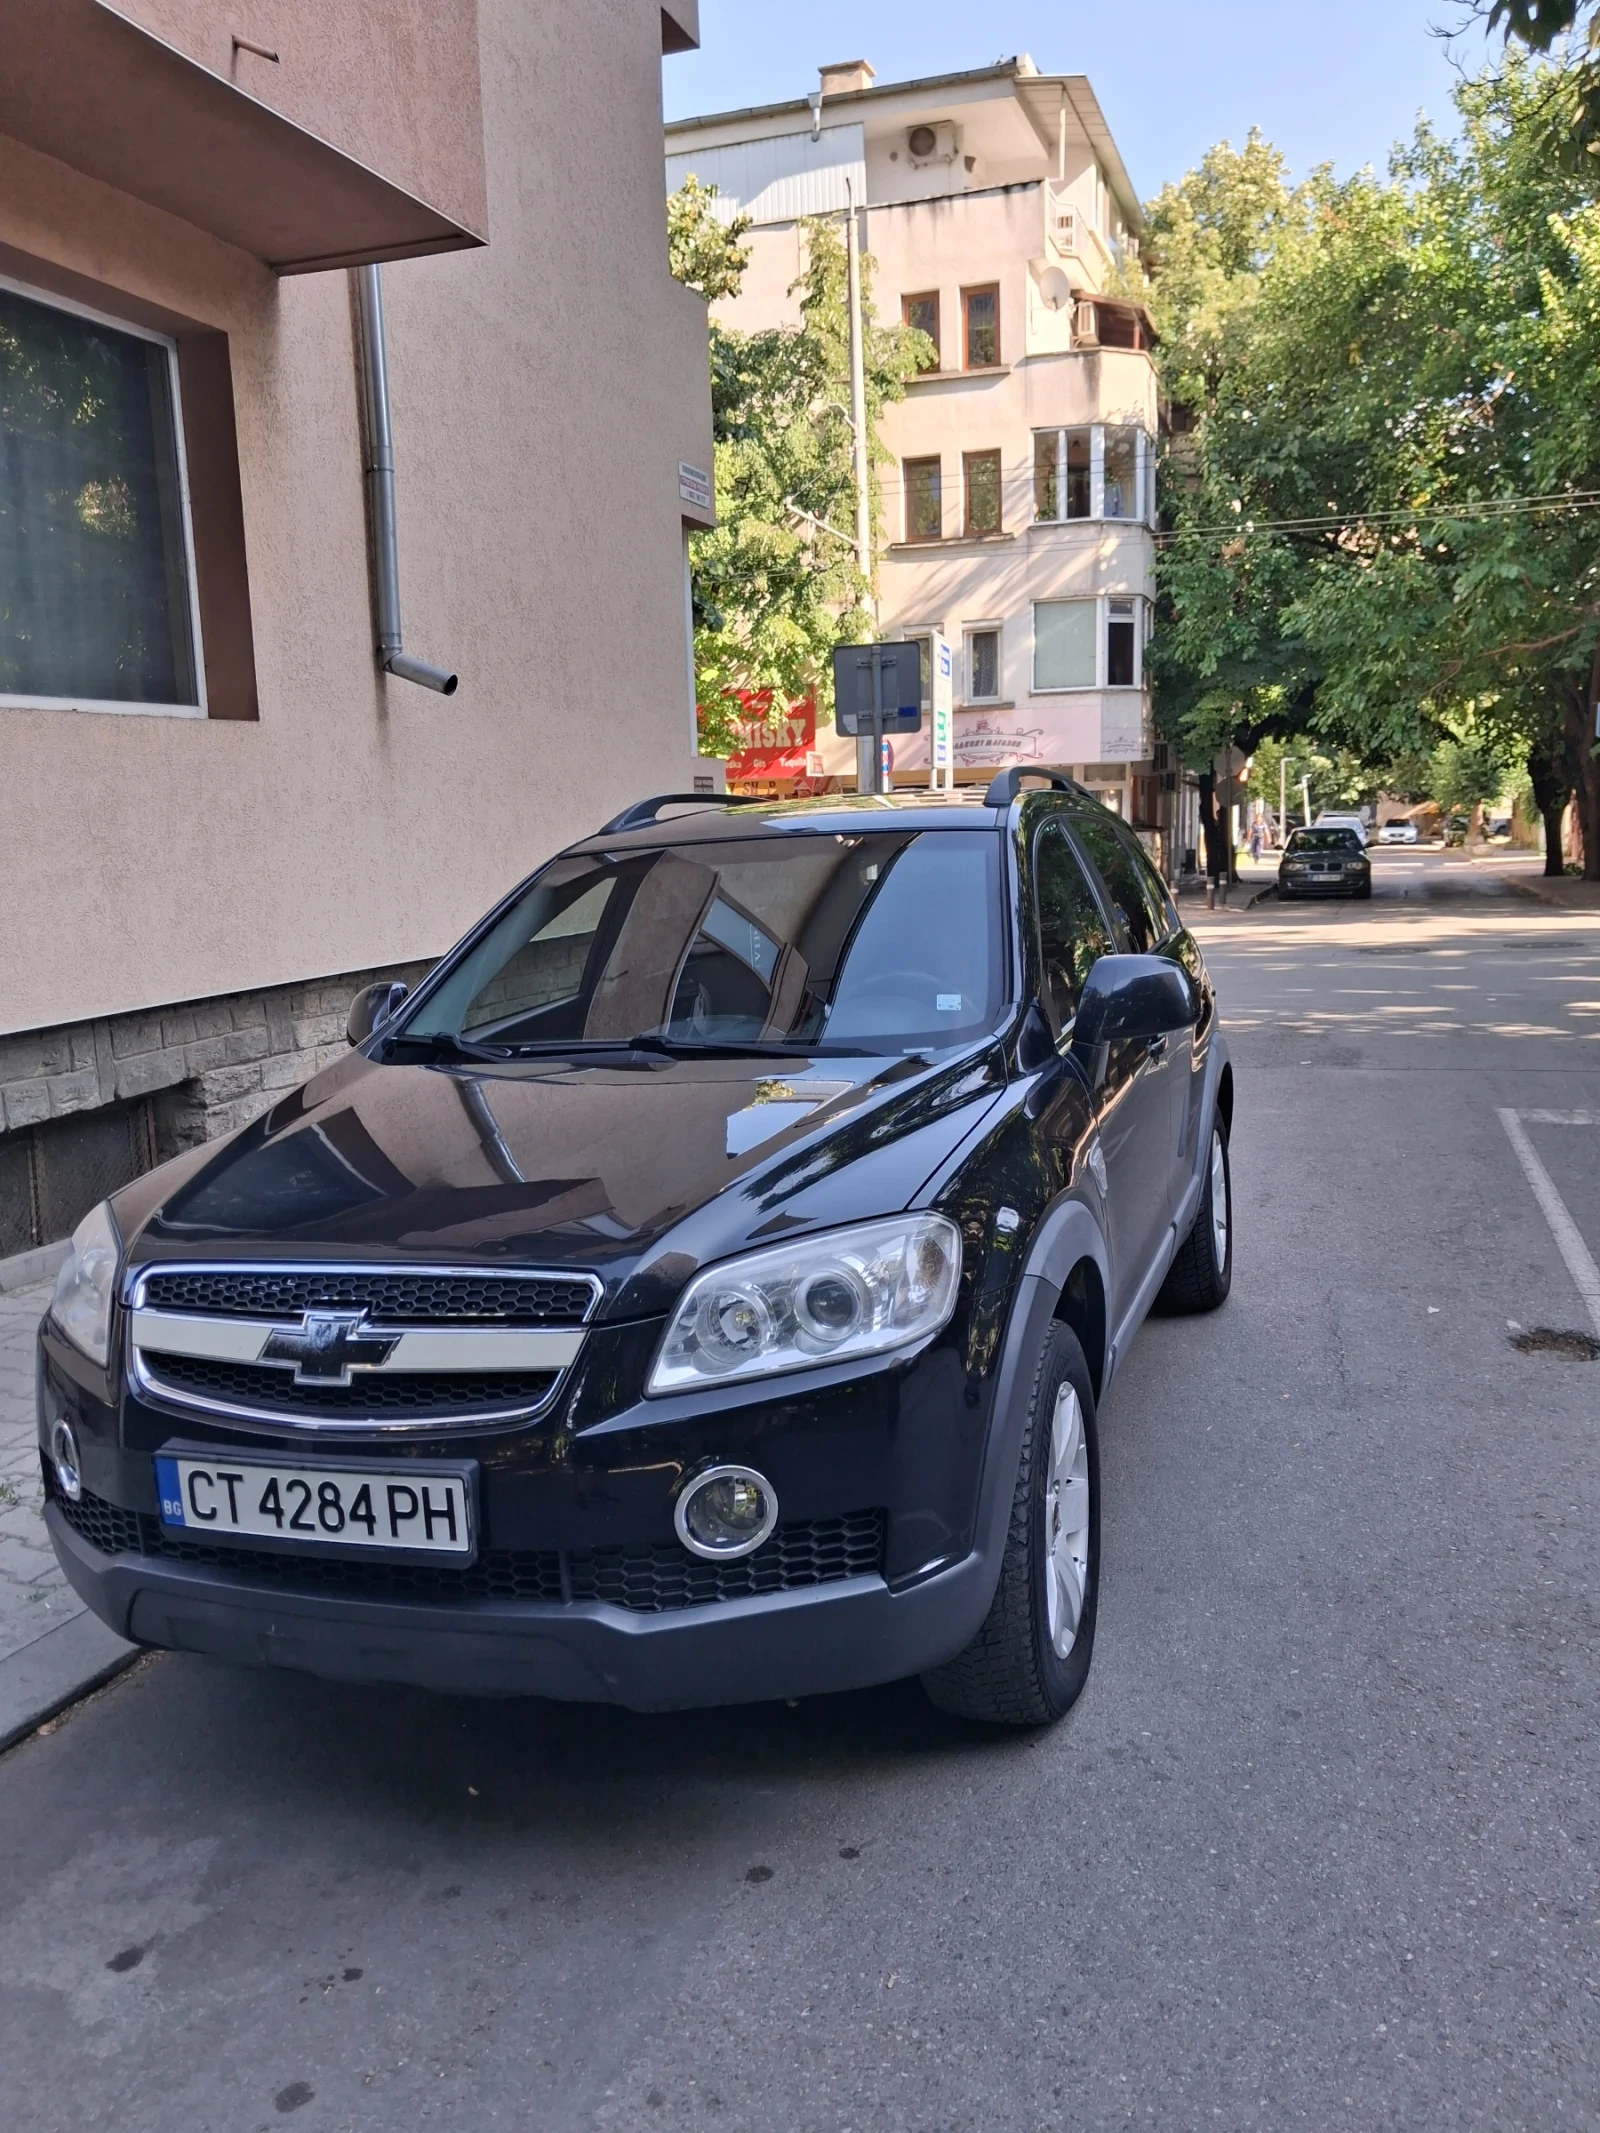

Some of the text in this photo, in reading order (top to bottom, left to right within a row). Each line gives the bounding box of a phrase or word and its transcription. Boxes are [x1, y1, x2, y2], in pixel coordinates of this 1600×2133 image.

[725, 760, 742, 769] odka
[163, 1500, 182, 1516] BG
[188, 1470, 457, 1541] CT 4284 PH
